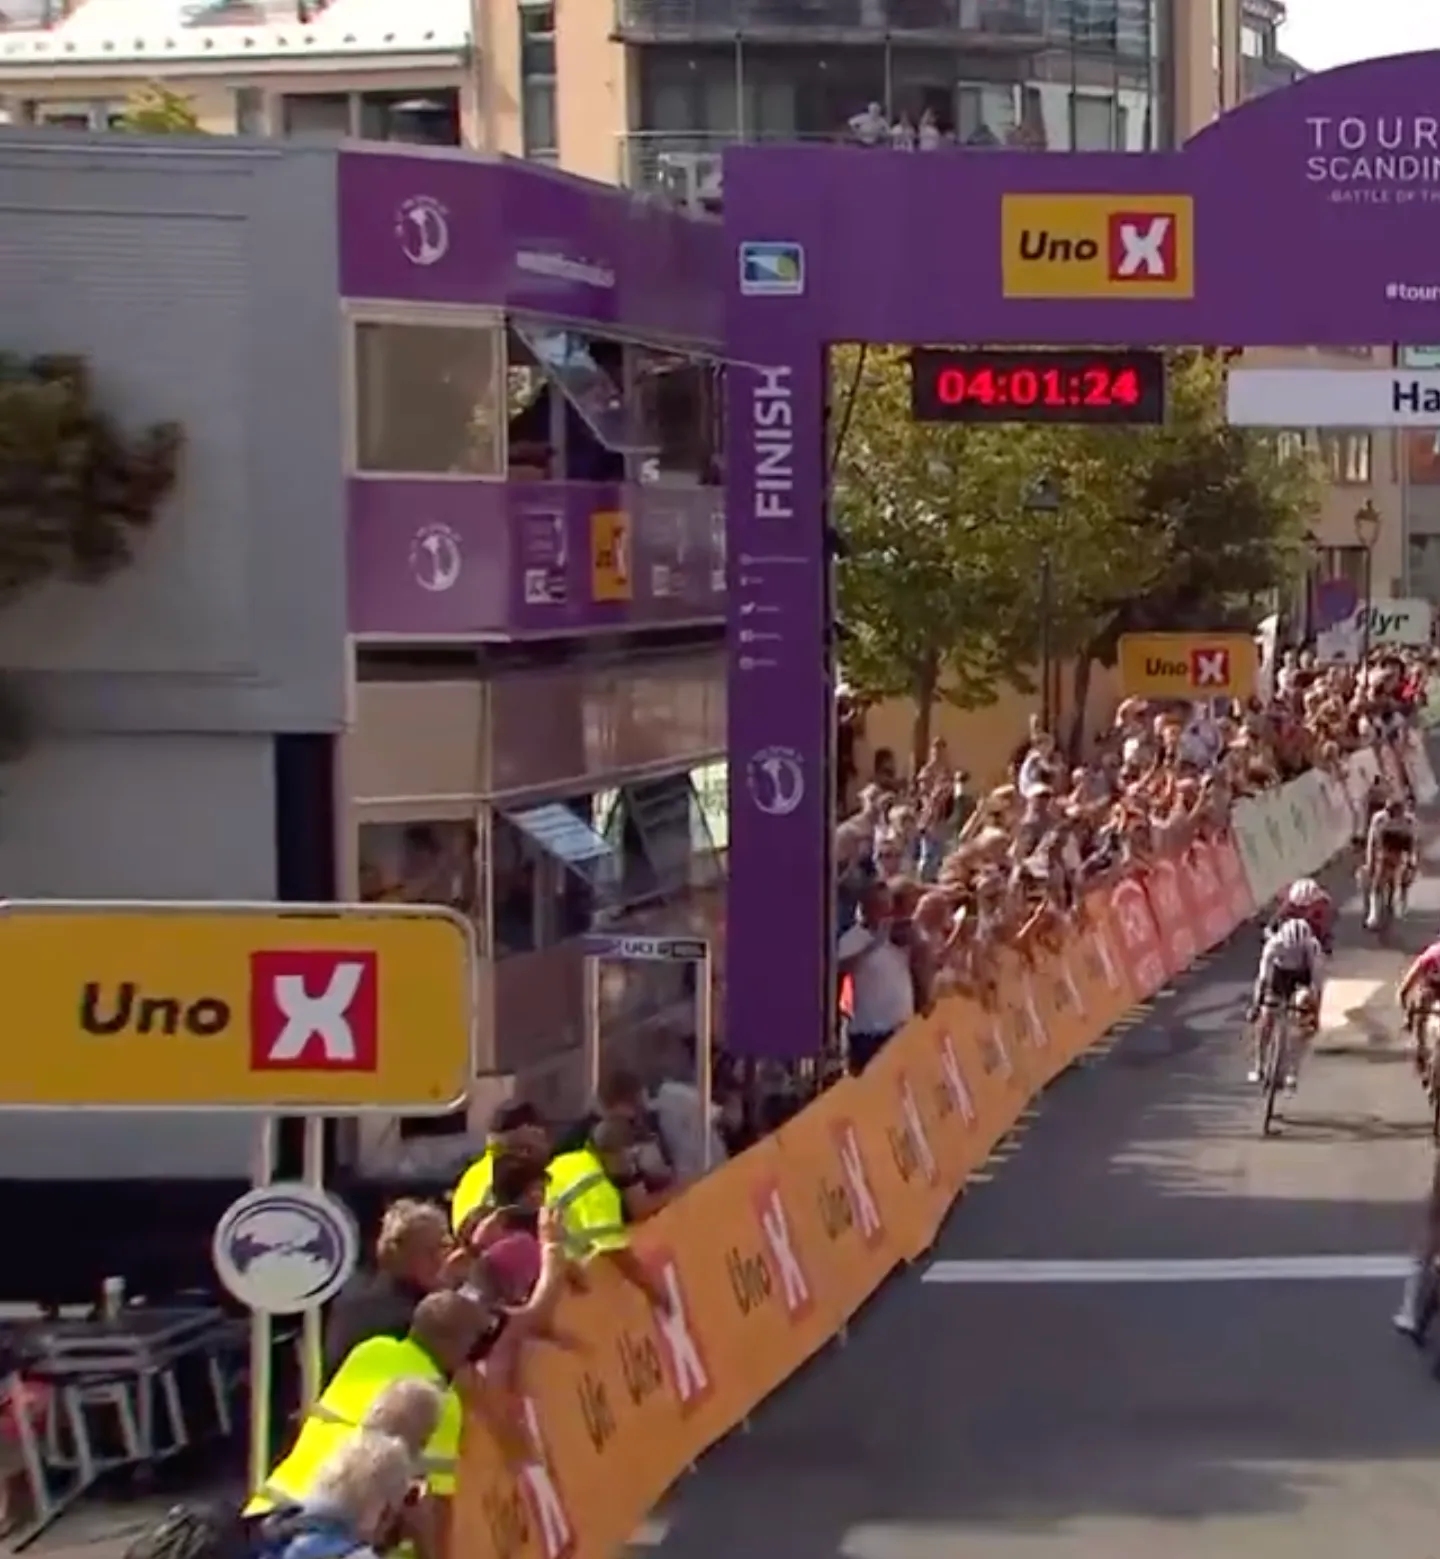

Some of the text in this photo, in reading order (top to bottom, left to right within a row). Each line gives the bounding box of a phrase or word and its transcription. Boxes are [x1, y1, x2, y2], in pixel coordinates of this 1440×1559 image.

[1306, 117, 1440, 150] TOUR
[1018, 215, 1171, 276] Uno X
[937, 366, 1139, 406] 04:01:24
[753, 365, 794, 519] FINISH
[1144, 651, 1229, 684] Uno X
[80, 962, 365, 1061] Uno X
[725, 1187, 810, 1318] Uno X
[618, 1329, 662, 1406] Uno
